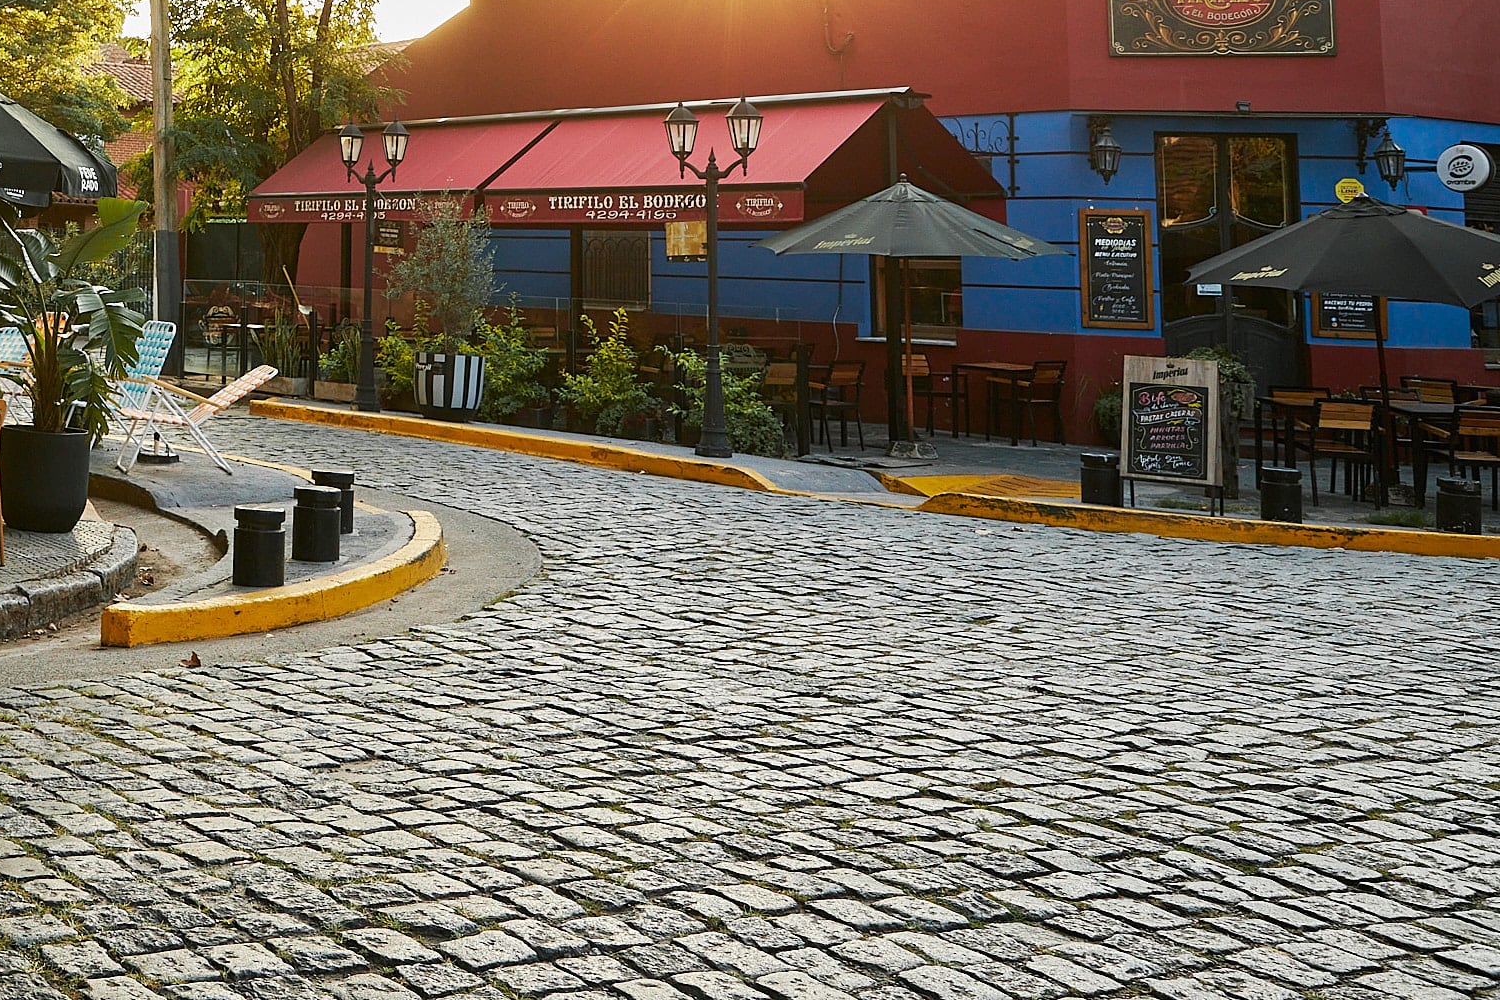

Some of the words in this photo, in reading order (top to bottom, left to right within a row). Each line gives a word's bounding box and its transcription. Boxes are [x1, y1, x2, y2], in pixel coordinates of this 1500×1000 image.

[1191, 8, 1204, 18] EL
[78, 166, 98, 180] FEDE
[81, 179, 99, 192] RADO
[294, 200, 341, 212] TIRIFILO
[344, 199, 359, 211] EL
[548, 195, 613, 209] TIRIFILO
[619, 195, 639, 209] EL
[643, 194, 719, 208] BODEGO
[585, 209, 677, 220] 4294-4195
[813, 236, 876, 250] Imperial
[1153, 367, 1189, 380] Imperial
[1140, 413, 1164, 422] PASTAS
